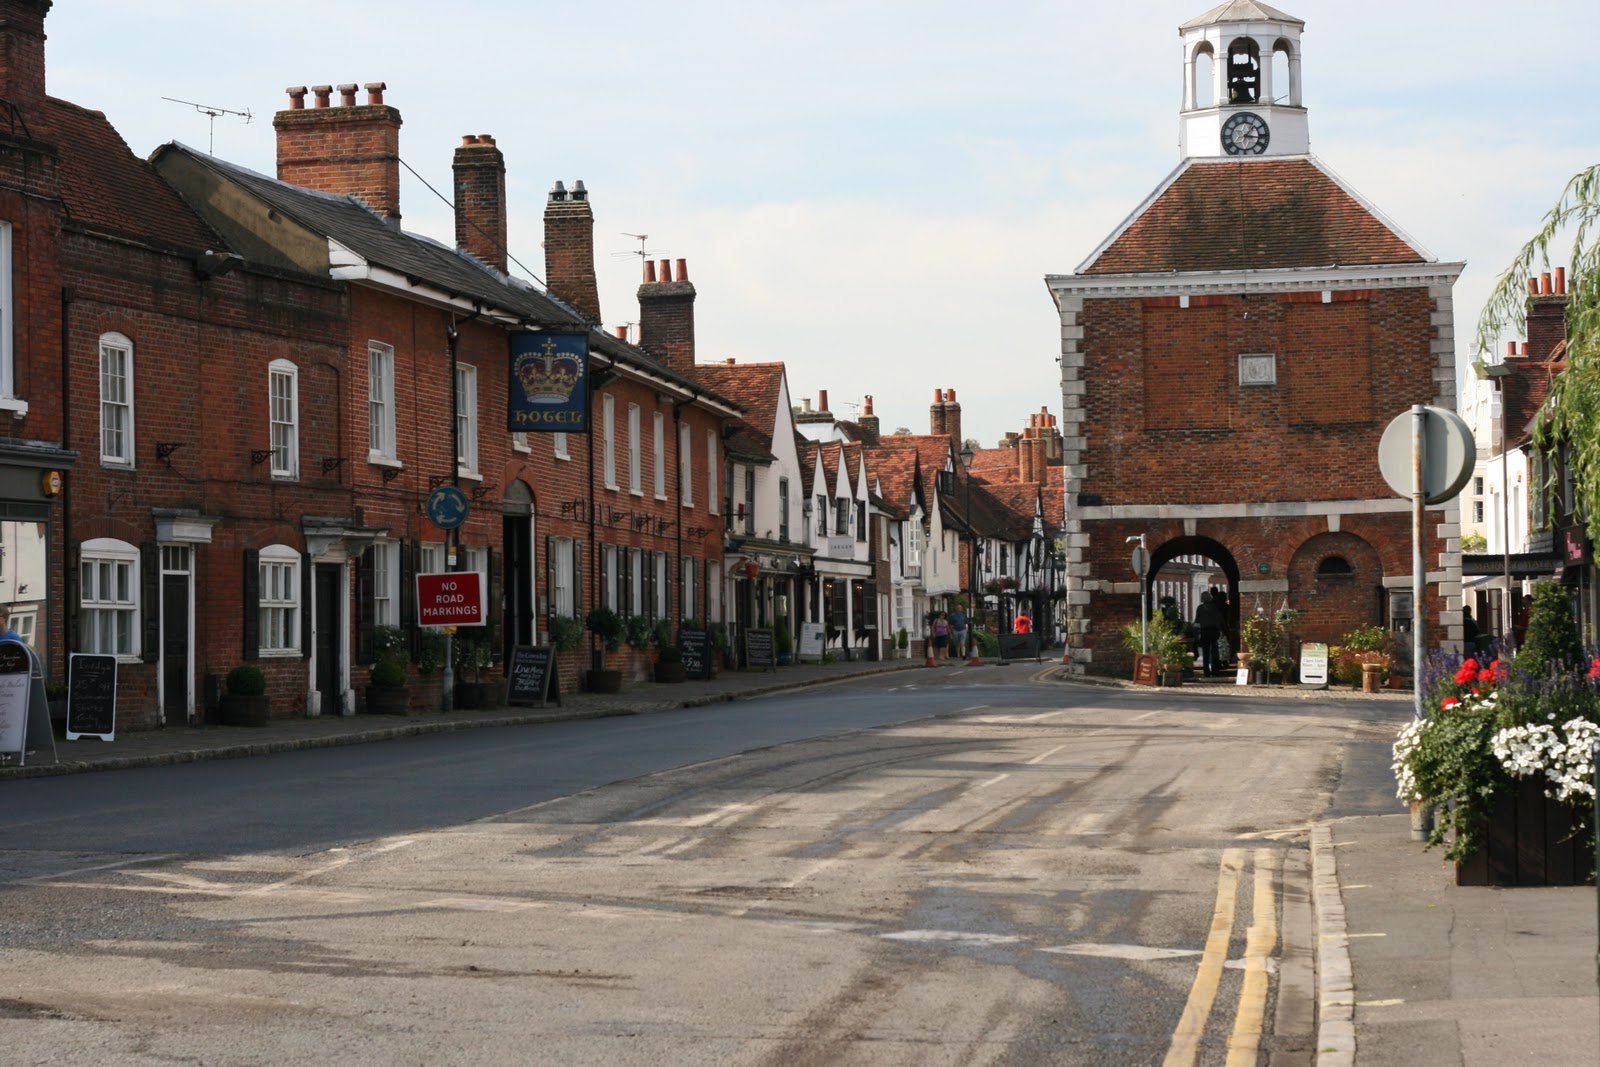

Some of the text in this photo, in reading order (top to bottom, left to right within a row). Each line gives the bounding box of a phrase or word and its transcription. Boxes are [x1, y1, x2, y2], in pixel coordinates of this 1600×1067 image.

[442, 582, 457, 591] NO
[436, 594, 464, 604] ROAD
[423, 606, 478, 616] MARKINGS
